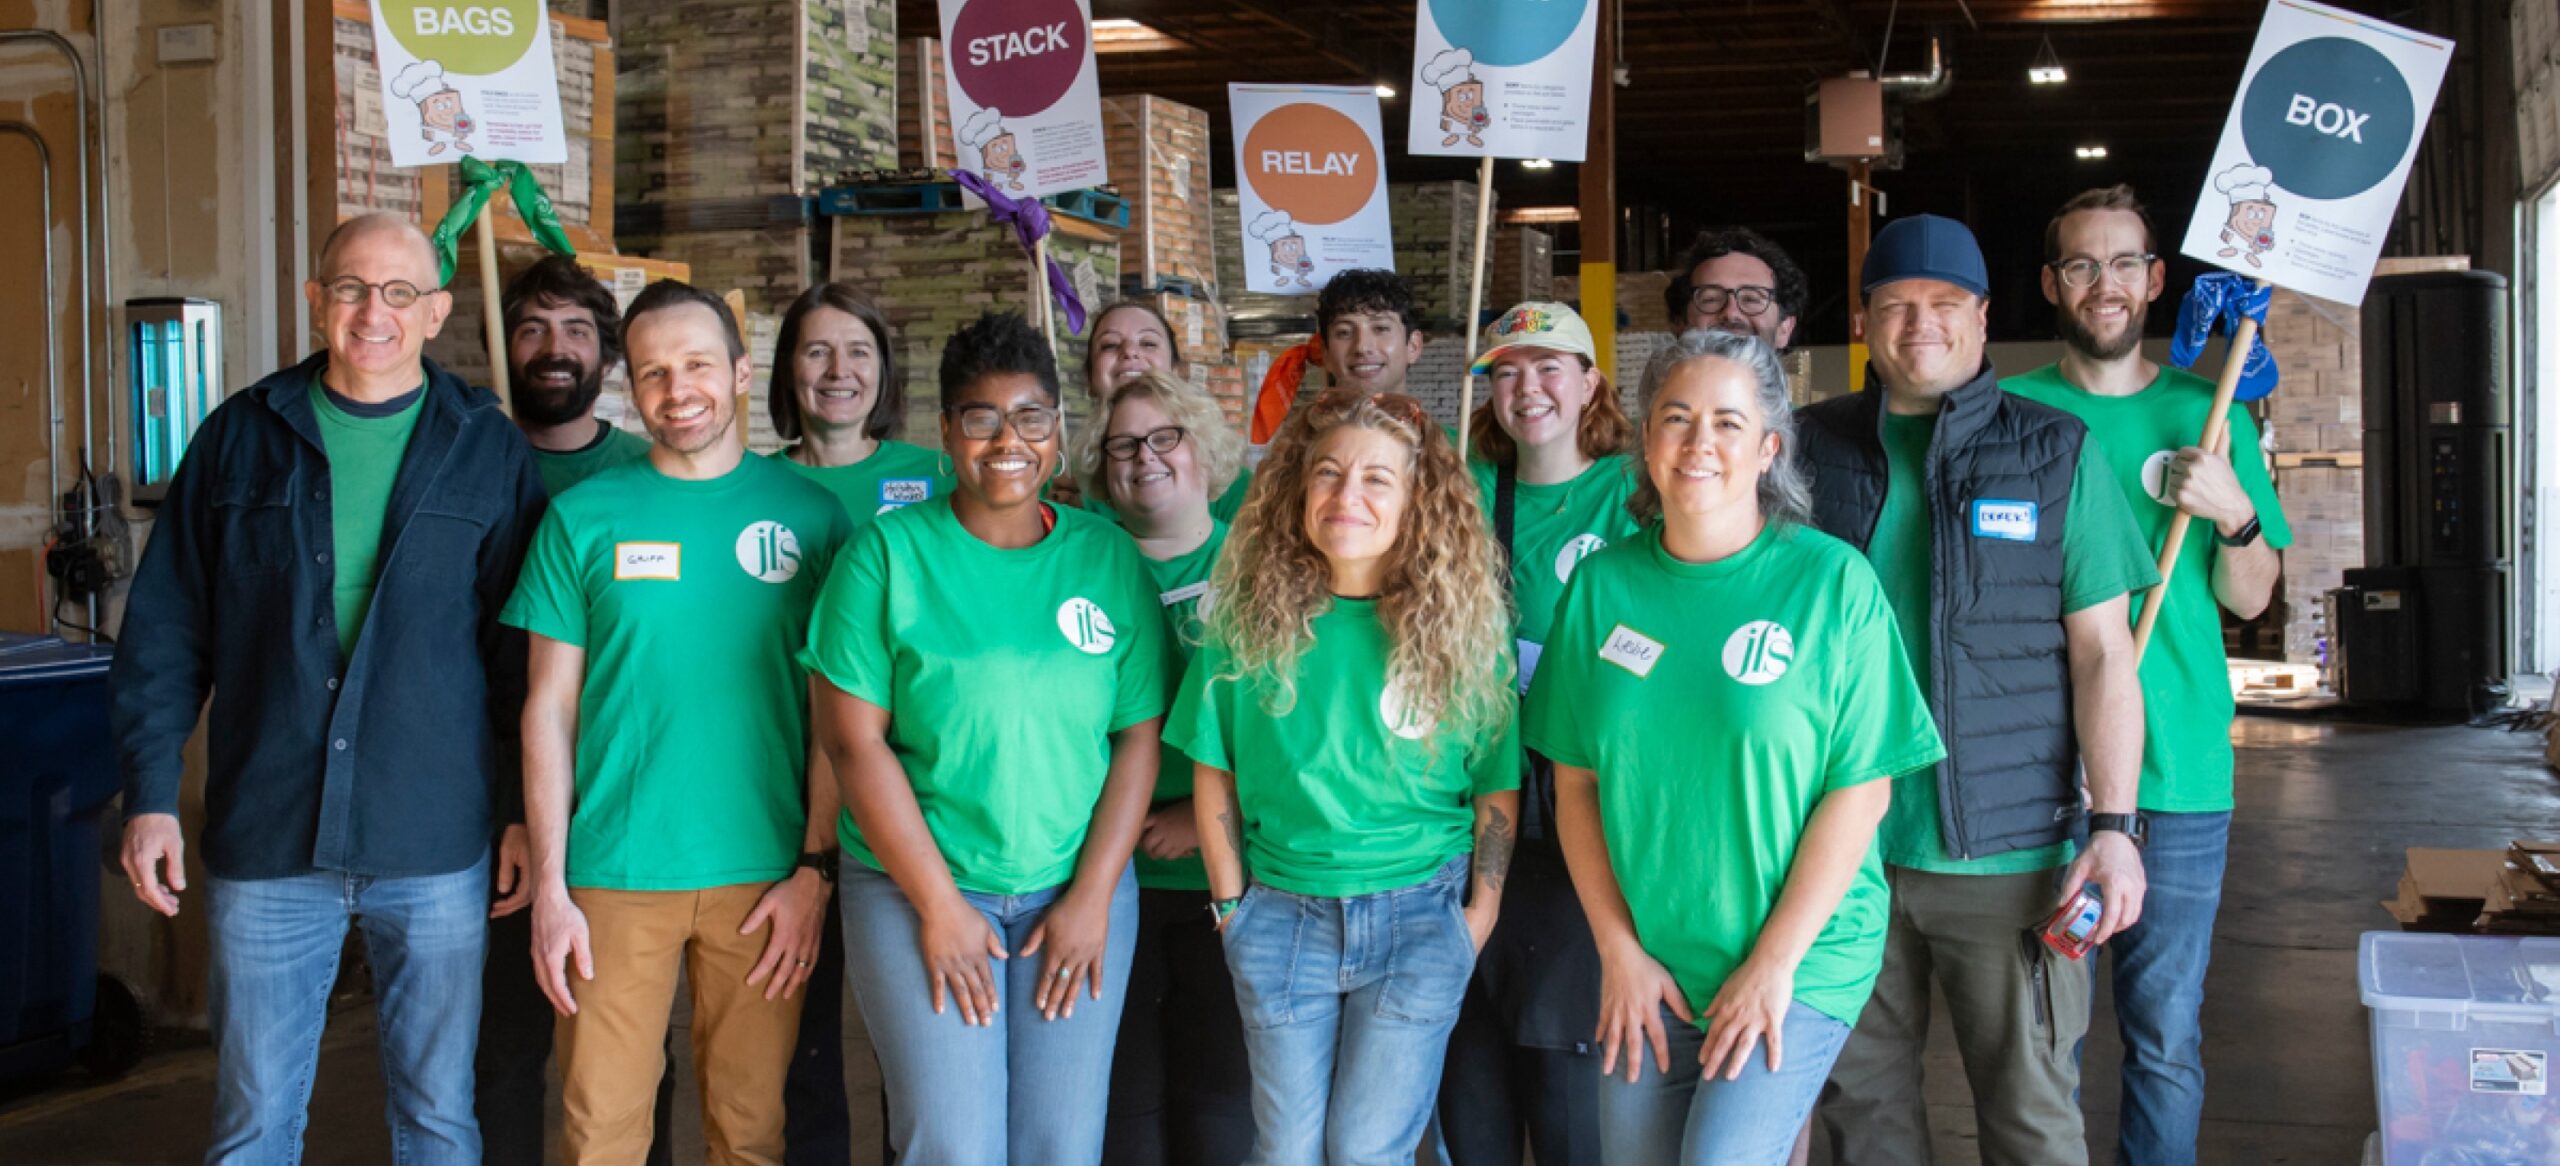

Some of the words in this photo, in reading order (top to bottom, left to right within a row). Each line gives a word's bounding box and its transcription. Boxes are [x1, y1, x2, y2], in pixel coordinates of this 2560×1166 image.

[413, 6, 514, 36] BAGS
[968, 21, 1069, 66] STACK
[2285, 93, 2371, 144] BOX
[1262, 150, 1359, 177] RELAY
[1737, 622, 1794, 678] jfs
